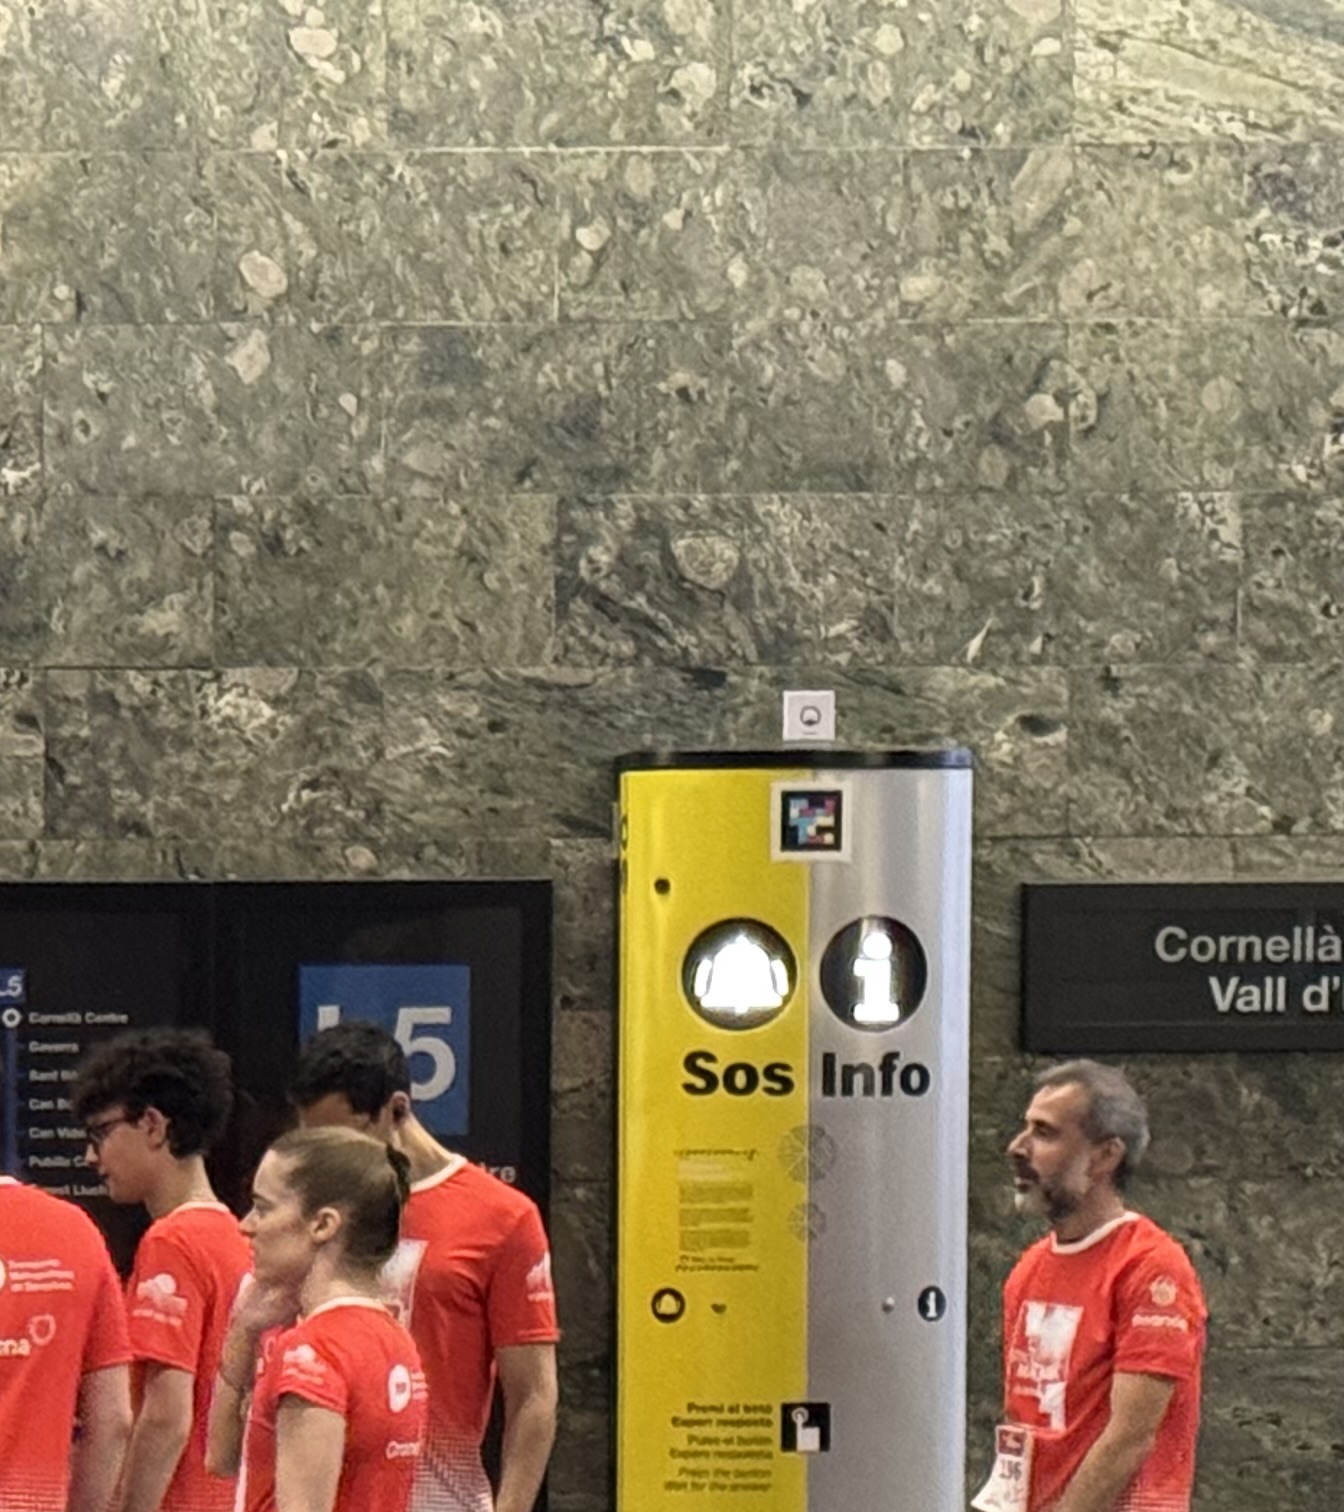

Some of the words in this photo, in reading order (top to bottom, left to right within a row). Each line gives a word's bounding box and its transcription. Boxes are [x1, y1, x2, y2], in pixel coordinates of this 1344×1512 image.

[1155, 925, 1342, 963] Cornellà
[1209, 975, 1286, 1013] Vall
[1303, 975, 1344, 1013] d'
[681, 1050, 796, 1097] Sos
[822, 1051, 932, 1097] Info
